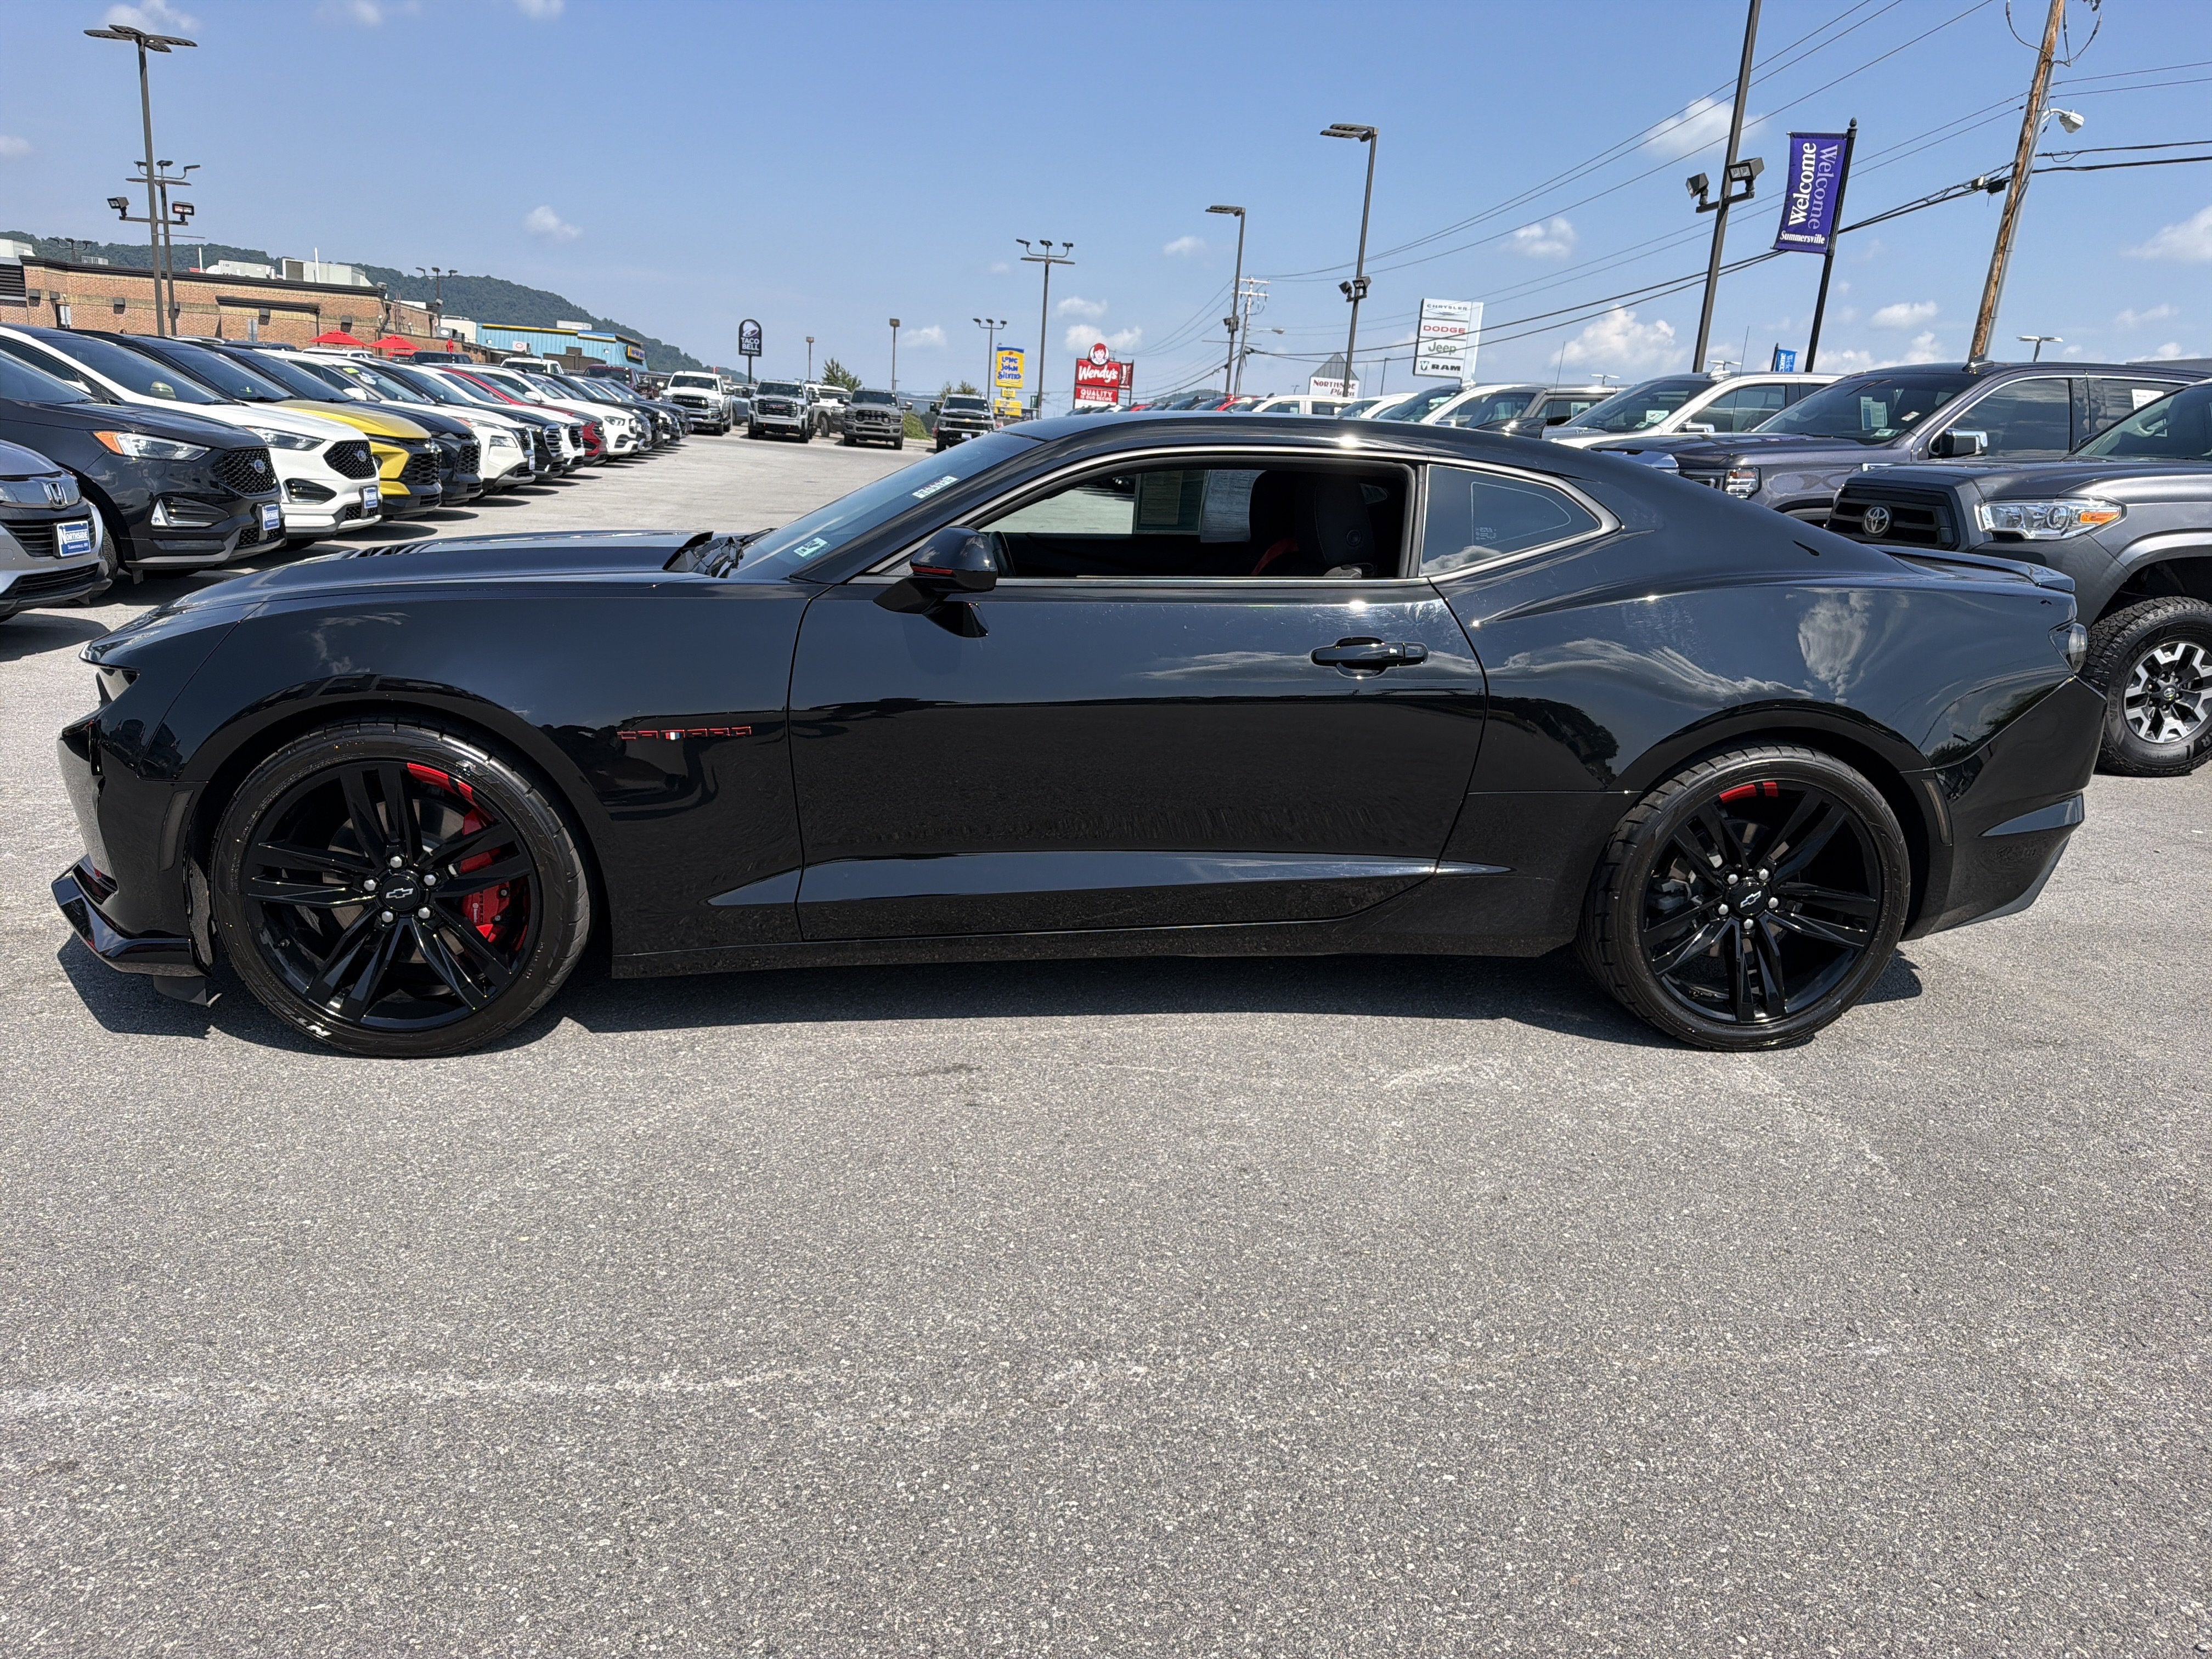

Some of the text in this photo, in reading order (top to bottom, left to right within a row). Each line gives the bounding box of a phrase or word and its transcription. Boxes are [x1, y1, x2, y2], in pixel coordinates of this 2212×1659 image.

[1788, 143, 1816, 227] Welcome
[1808, 144, 1838, 229] Welcome
[1780, 230, 1825, 244] Summersville
[1423, 325, 1465, 334] DODGE
[1428, 342, 1457, 356] Jeep
[1078, 364, 1118, 383] Wendy's
[1313, 380, 1356, 390] NORTHSDE
[1080, 388, 1113, 397] QUALITY
[59, 528, 88, 545] NORTHSIDE
